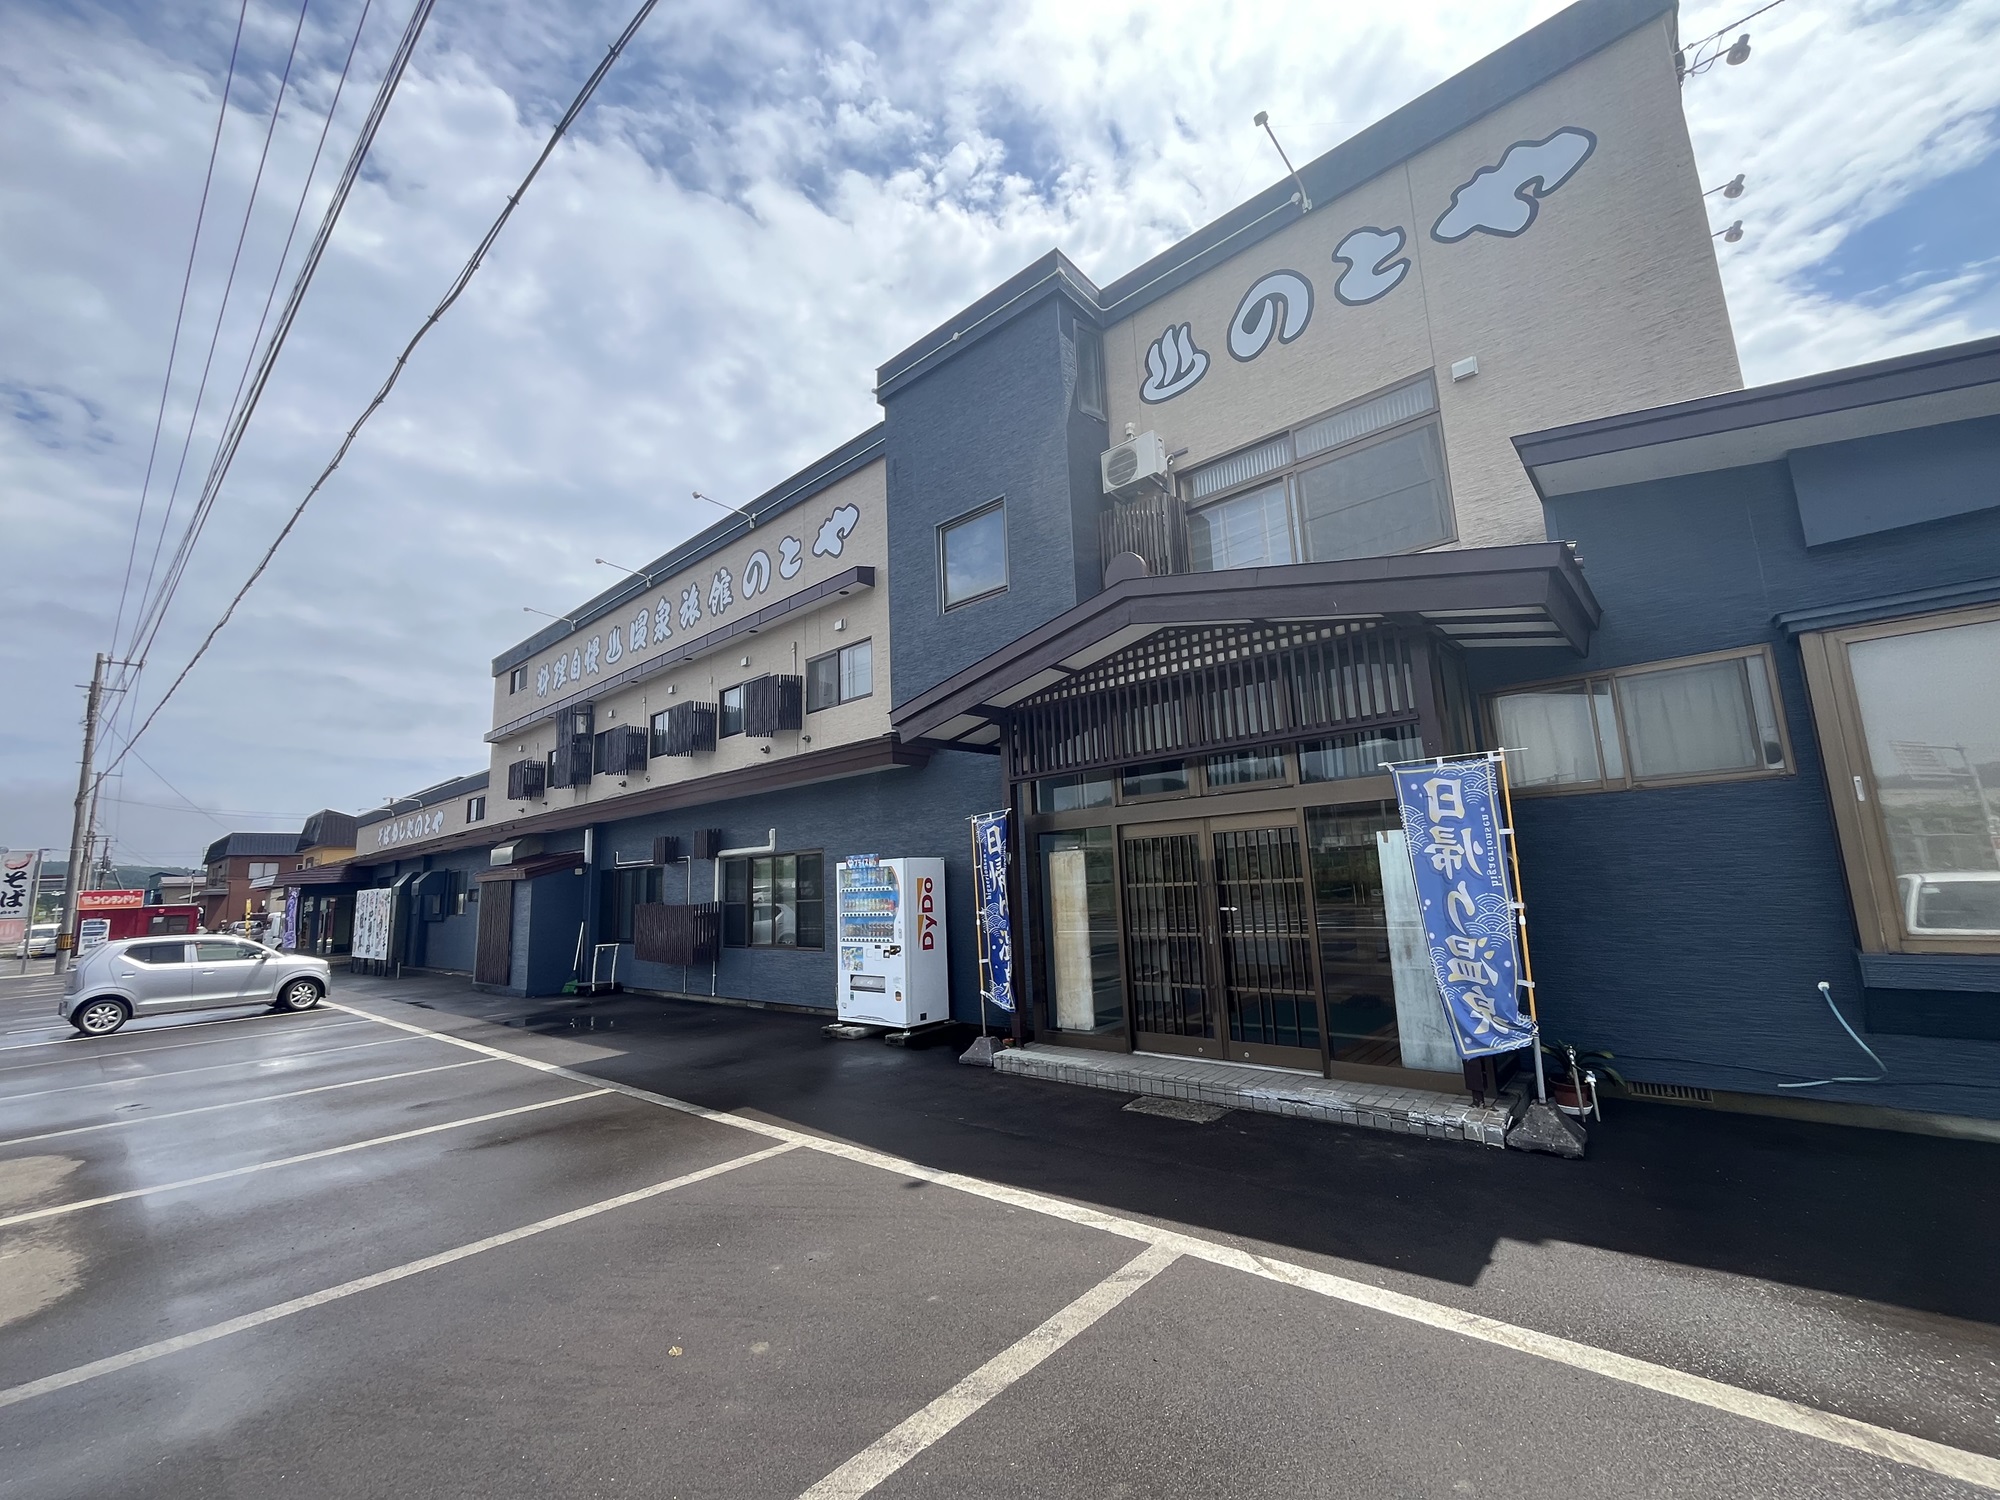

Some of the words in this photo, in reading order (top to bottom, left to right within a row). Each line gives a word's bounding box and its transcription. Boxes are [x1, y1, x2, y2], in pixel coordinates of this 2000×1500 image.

[1227, 126, 1597, 362] のとや
[0, 871, 27, 908] そば
